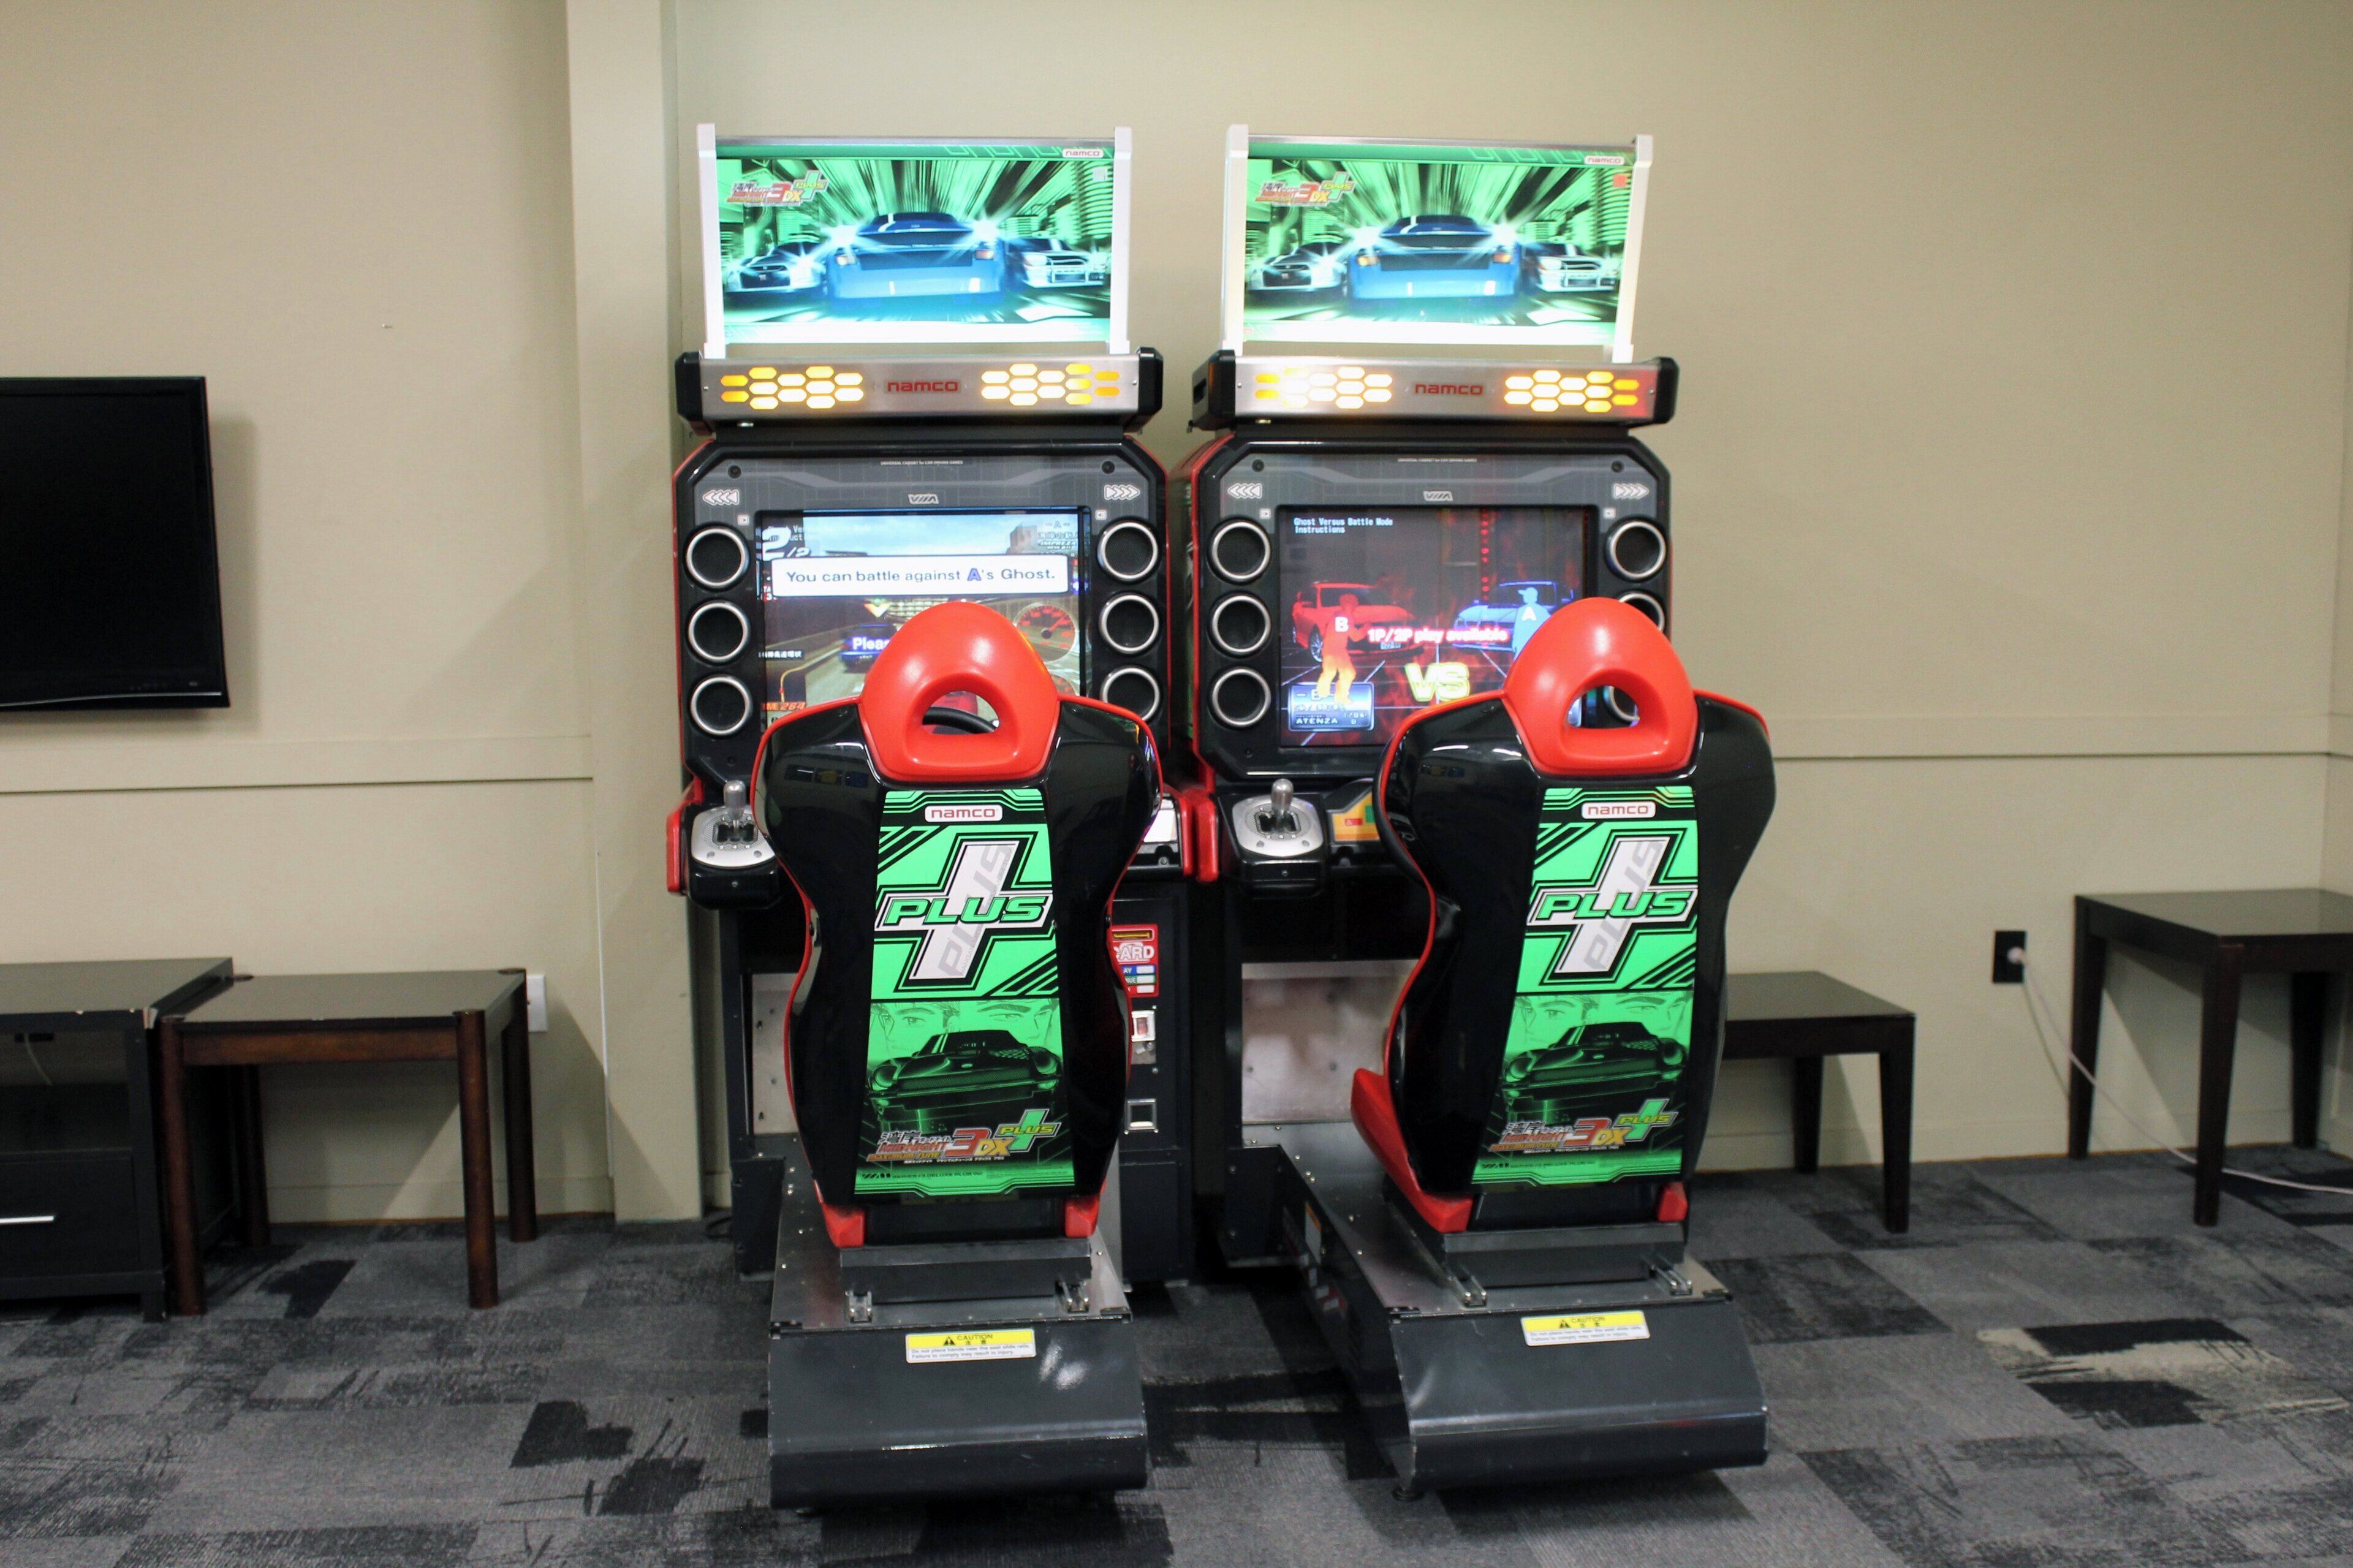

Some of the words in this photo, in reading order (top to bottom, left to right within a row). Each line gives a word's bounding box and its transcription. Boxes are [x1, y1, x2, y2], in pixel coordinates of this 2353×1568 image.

[887, 381, 958, 392] namco
[1414, 384, 1483, 395] namco
[1294, 518, 1316, 526] Ghost
[1319, 518, 1346, 526] Versus
[1347, 518, 1374, 526] Battle
[1376, 518, 1393, 526] Mode
[787, 571, 816, 583] You
[822, 573, 852, 582] can
[857, 570, 900, 582] battle
[905, 570, 960, 583] against
[1001, 569, 1055, 580] Ghost.
[1521, 606, 1537, 621] A
[1335, 616, 1349, 632] B
[1367, 627, 1413, 643] 1P/2P
[1414, 627, 1444, 644] play
[1446, 627, 1509, 643] available
[1404, 661, 1471, 702] VS
[931, 808, 996, 819] namco
[1588, 805, 1649, 816] namco
[884, 896, 1046, 925] PLUS
[1536, 891, 1692, 919] PLUS
[1591, 1128, 1634, 1146] DX
[1620, 1115, 1670, 1124] PLUS
[945, 1127, 991, 1156] 3
[974, 1138, 1015, 1156] DX
[1000, 1125, 1055, 1135] PLUS
